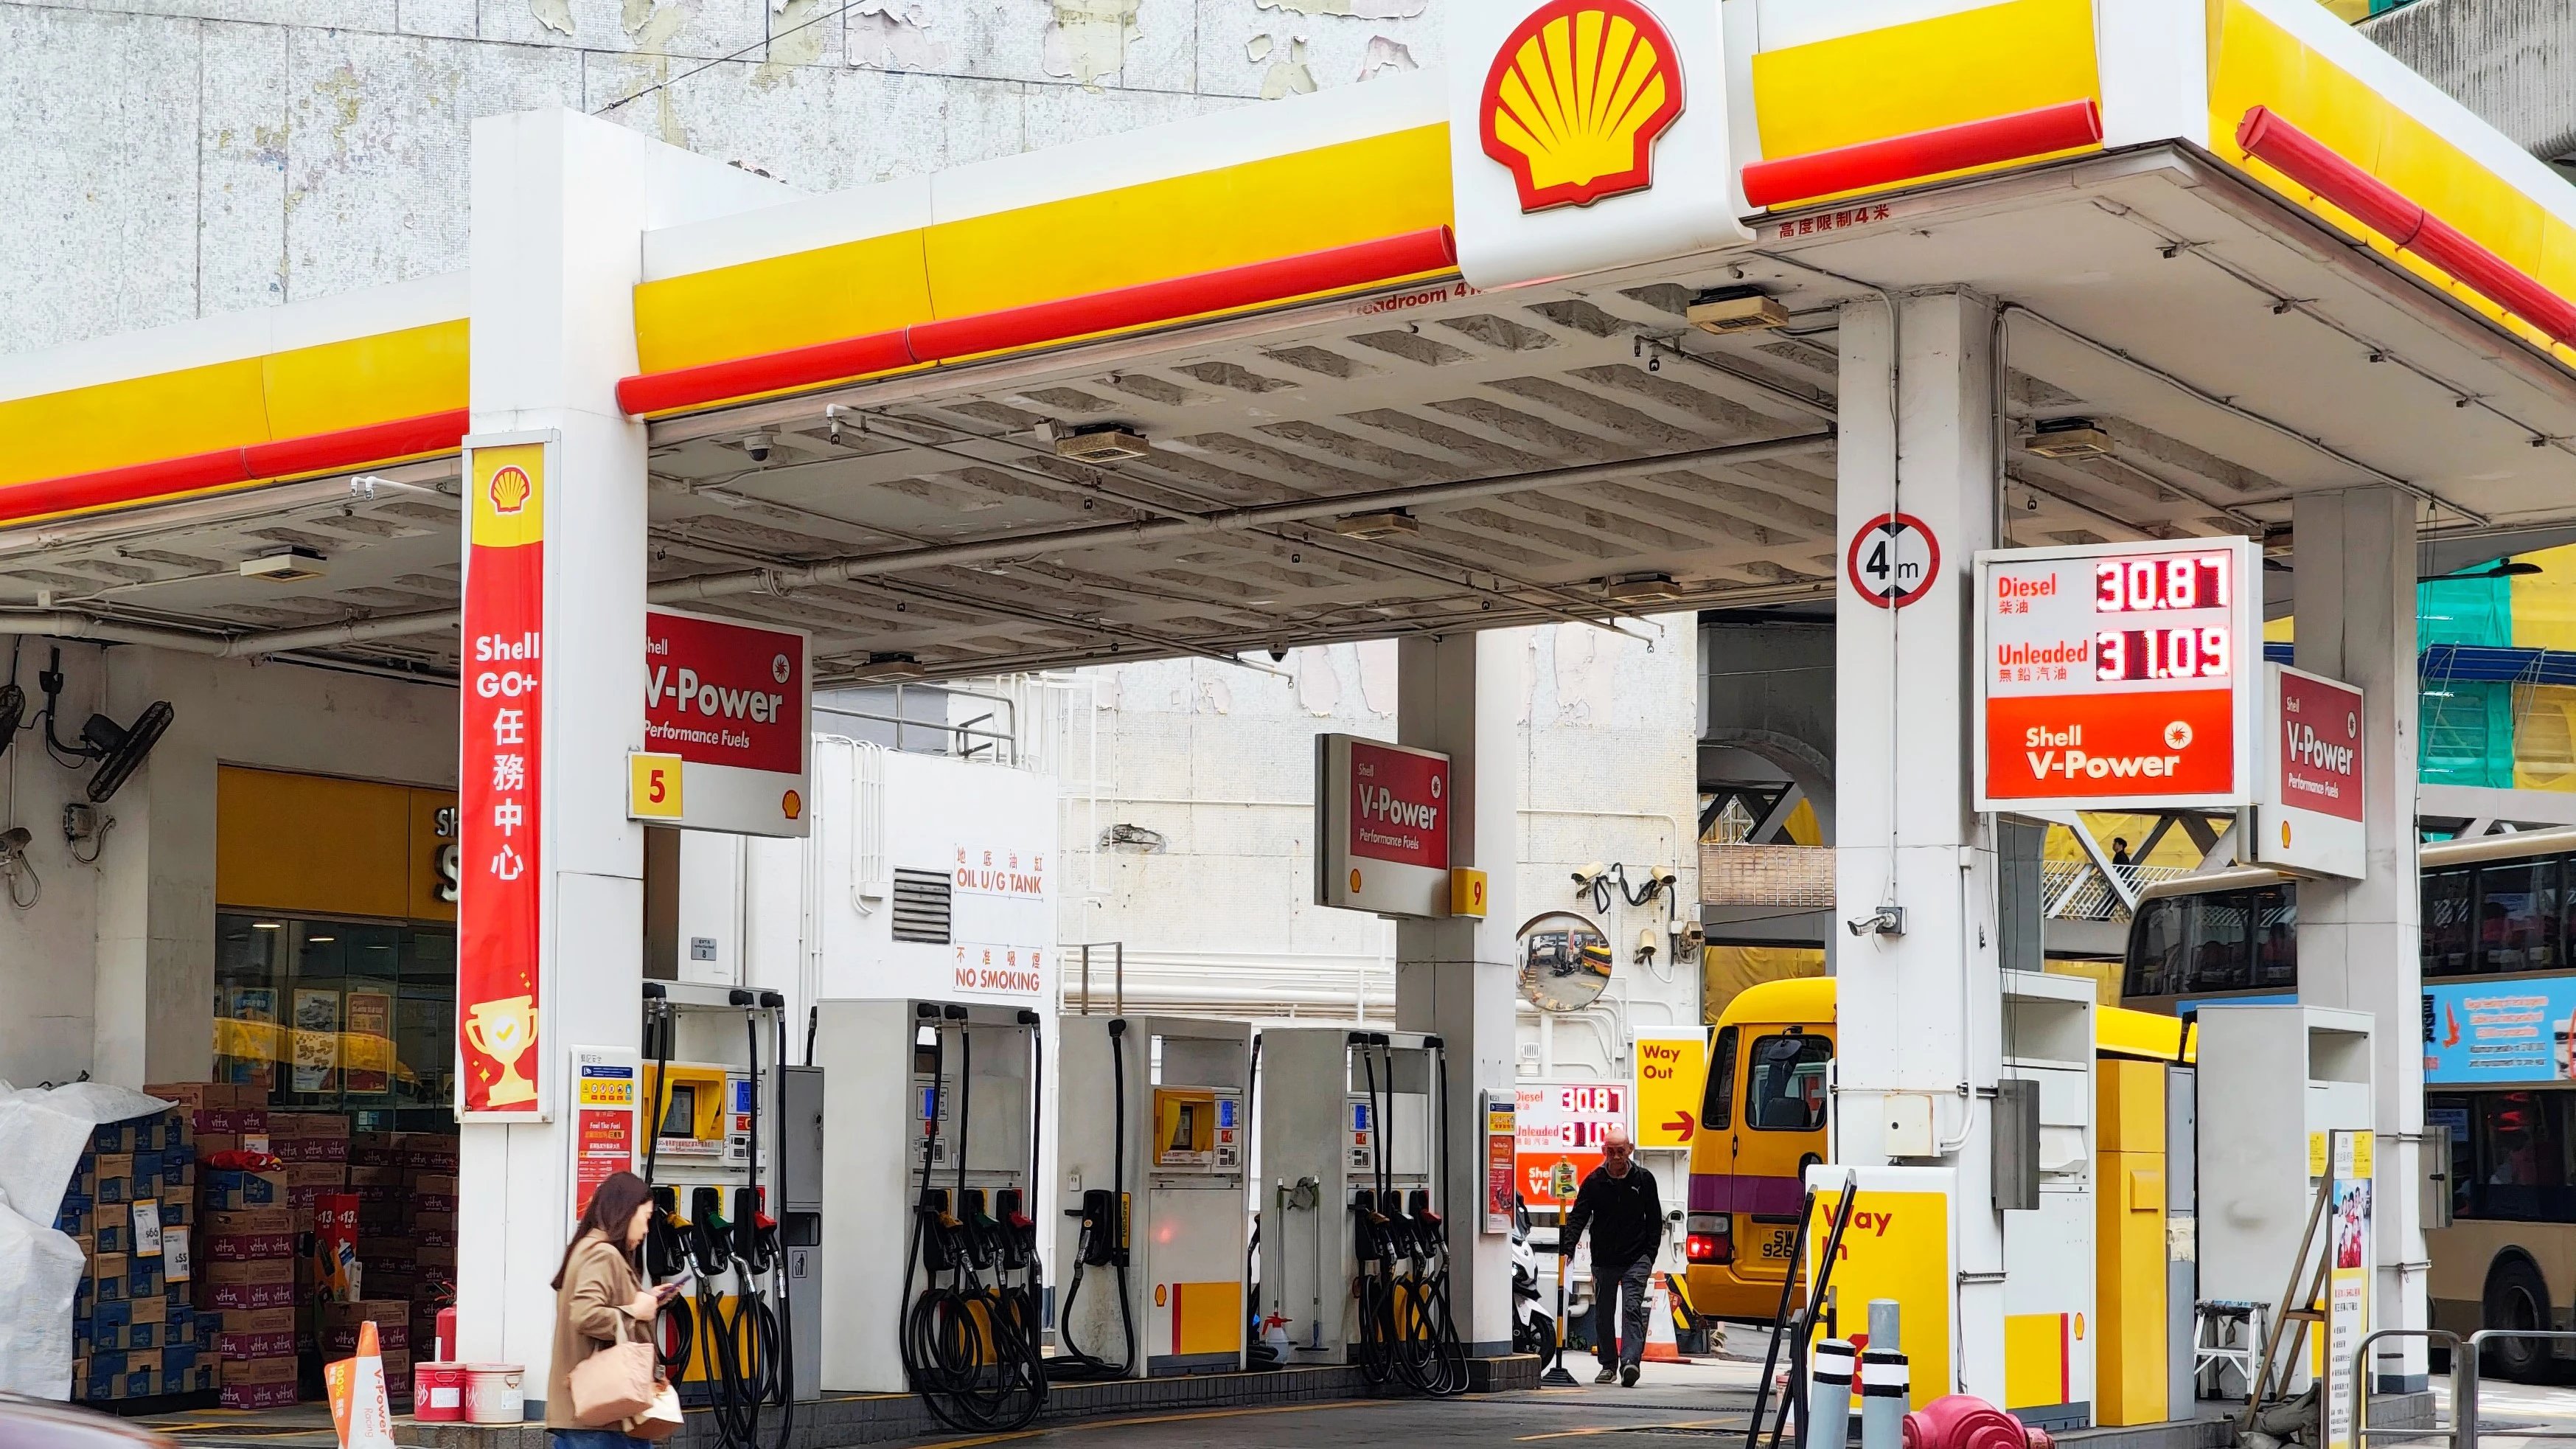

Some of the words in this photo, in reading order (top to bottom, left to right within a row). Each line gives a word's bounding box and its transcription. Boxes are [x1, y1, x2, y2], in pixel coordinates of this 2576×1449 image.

[1778, 203, 1890, 239] 高度限制4米
[1866, 541, 1890, 580] 4
[1897, 558, 1920, 580] m
[1998, 573, 2057, 598] Diesel
[2097, 556, 2229, 612] 30.87
[1998, 599, 2030, 615] 柴油
[476, 632, 540, 661] Shell
[646, 637, 668, 656] hell
[1998, 639, 2089, 666] Unleaded
[2097, 627, 2229, 681] 31.09
[476, 670, 538, 699] GO+
[1998, 667, 2068, 683] 無鉛汽油
[646, 664, 783, 724] V-Power
[645, 718, 719, 745] Performance
[721, 729, 751, 749] Fuels
[2026, 725, 2082, 748] Shell
[2287, 720, 2353, 776] V-Power
[2026, 751, 2180, 780] V-Power
[490, 707, 525, 881] 任務中心
[650, 769, 666, 804] 5
[1358, 783, 1437, 830] V-Power
[1360, 828, 1402, 848] Performance
[957, 868, 977, 888] OIL
[981, 870, 1006, 892] U/G
[1009, 873, 1042, 894] TANK
[1475, 880, 1482, 906] 9
[955, 968, 976, 987] NO
[981, 970, 1040, 992] SMOKING
[1643, 1045, 1681, 1063] Way
[1643, 1065, 1674, 1079] Out
[1516, 1090, 1543, 1103] Diesel
[1562, 1088, 1624, 1113] 30.87
[1529, 1167, 1552, 1178] Shel
[1822, 1204, 1893, 1237] Way
[374, 1368, 387, 1436] V-Power
